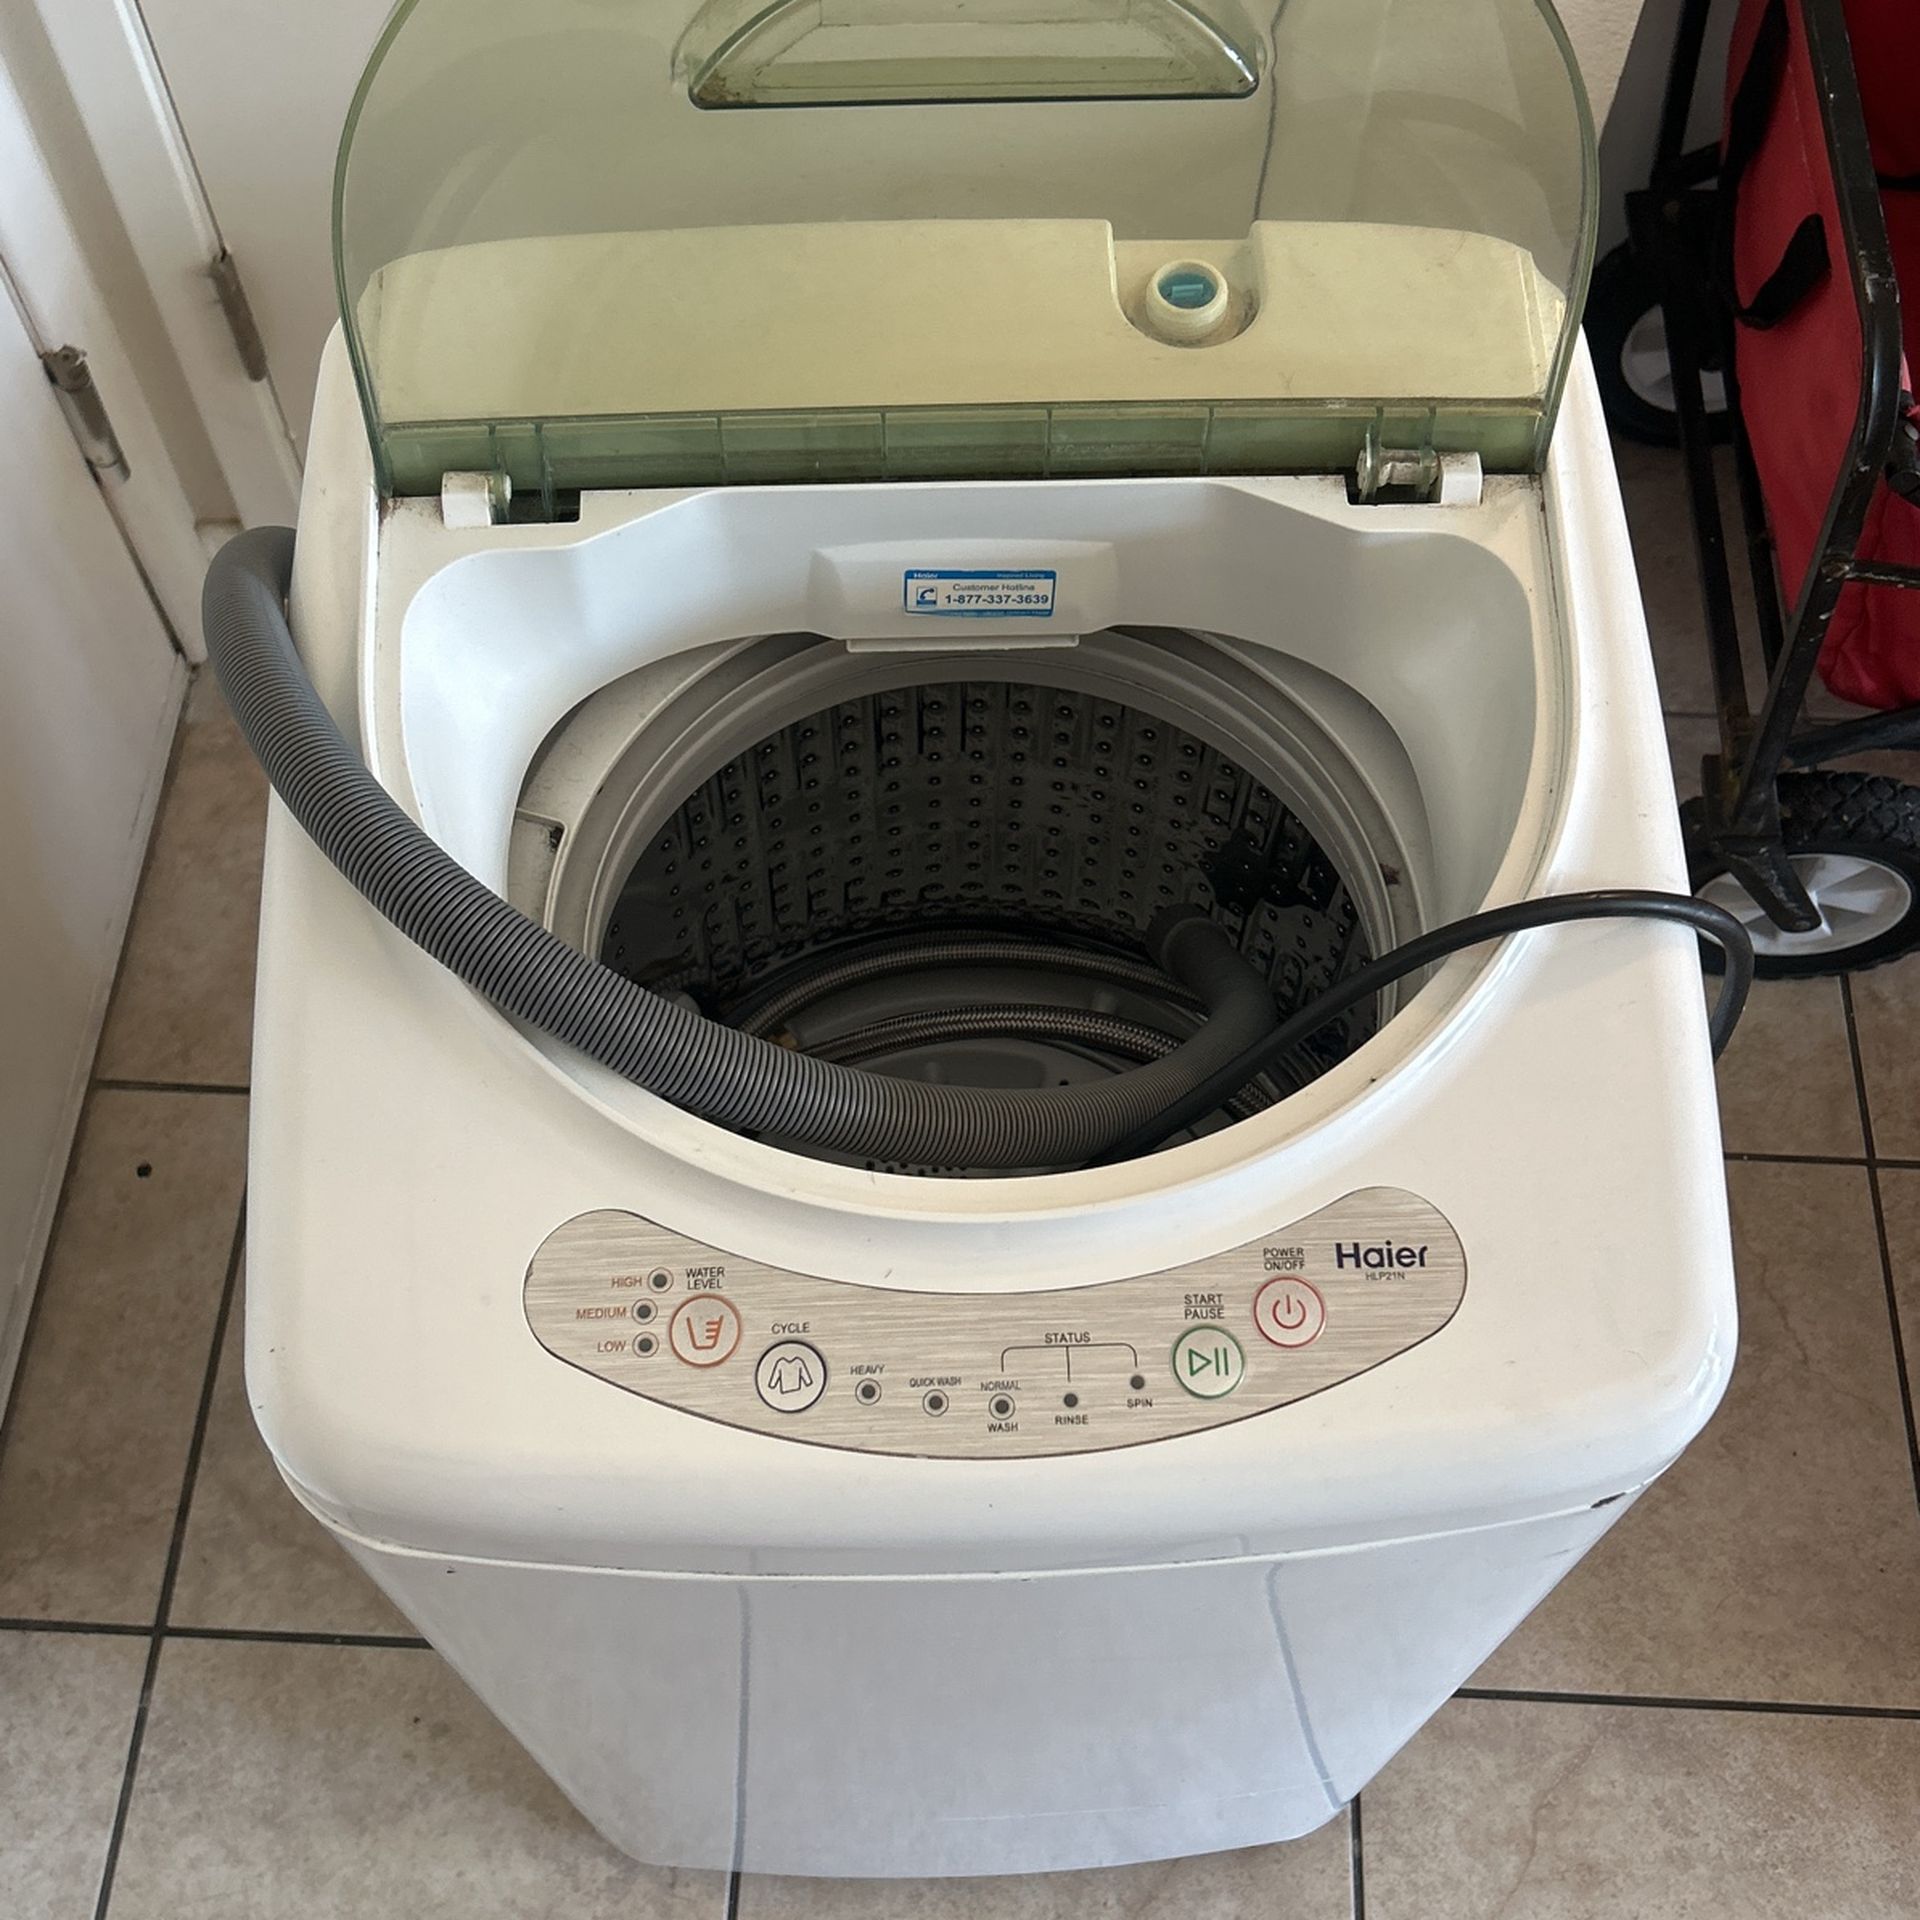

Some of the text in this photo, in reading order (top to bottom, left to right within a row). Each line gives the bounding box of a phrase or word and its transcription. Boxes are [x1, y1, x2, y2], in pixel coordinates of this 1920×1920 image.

[953, 583, 1035, 592] Customer Hotline
[945, 594, 1049, 604] 1-877-337-3639
[1263, 1247, 1304, 1257] POWER
[1335, 1240, 1428, 1269] Haier
[1264, 1260, 1305, 1271] ON/OFF
[686, 1267, 725, 1279] WATER
[1365, 1271, 1405, 1281] HLP21N
[611, 1276, 642, 1288] HIGH
[687, 1279, 723, 1290] LEVEL
[1184, 1294, 1223, 1305] START
[576, 1307, 627, 1320] MEDIUM
[1184, 1308, 1224, 1319] PAUSE
[771, 1322, 810, 1334] CYCLE
[1044, 1332, 1091, 1344] STATUS
[597, 1341, 626, 1353] LOW
[850, 1364, 885, 1375] HEAVY
[909, 1376, 962, 1388] QUICK WASH
[980, 1380, 1021, 1391] NORMAL
[1127, 1398, 1153, 1409] SPIN
[1055, 1414, 1089, 1425] RINSE
[987, 1422, 1019, 1433] WASH
